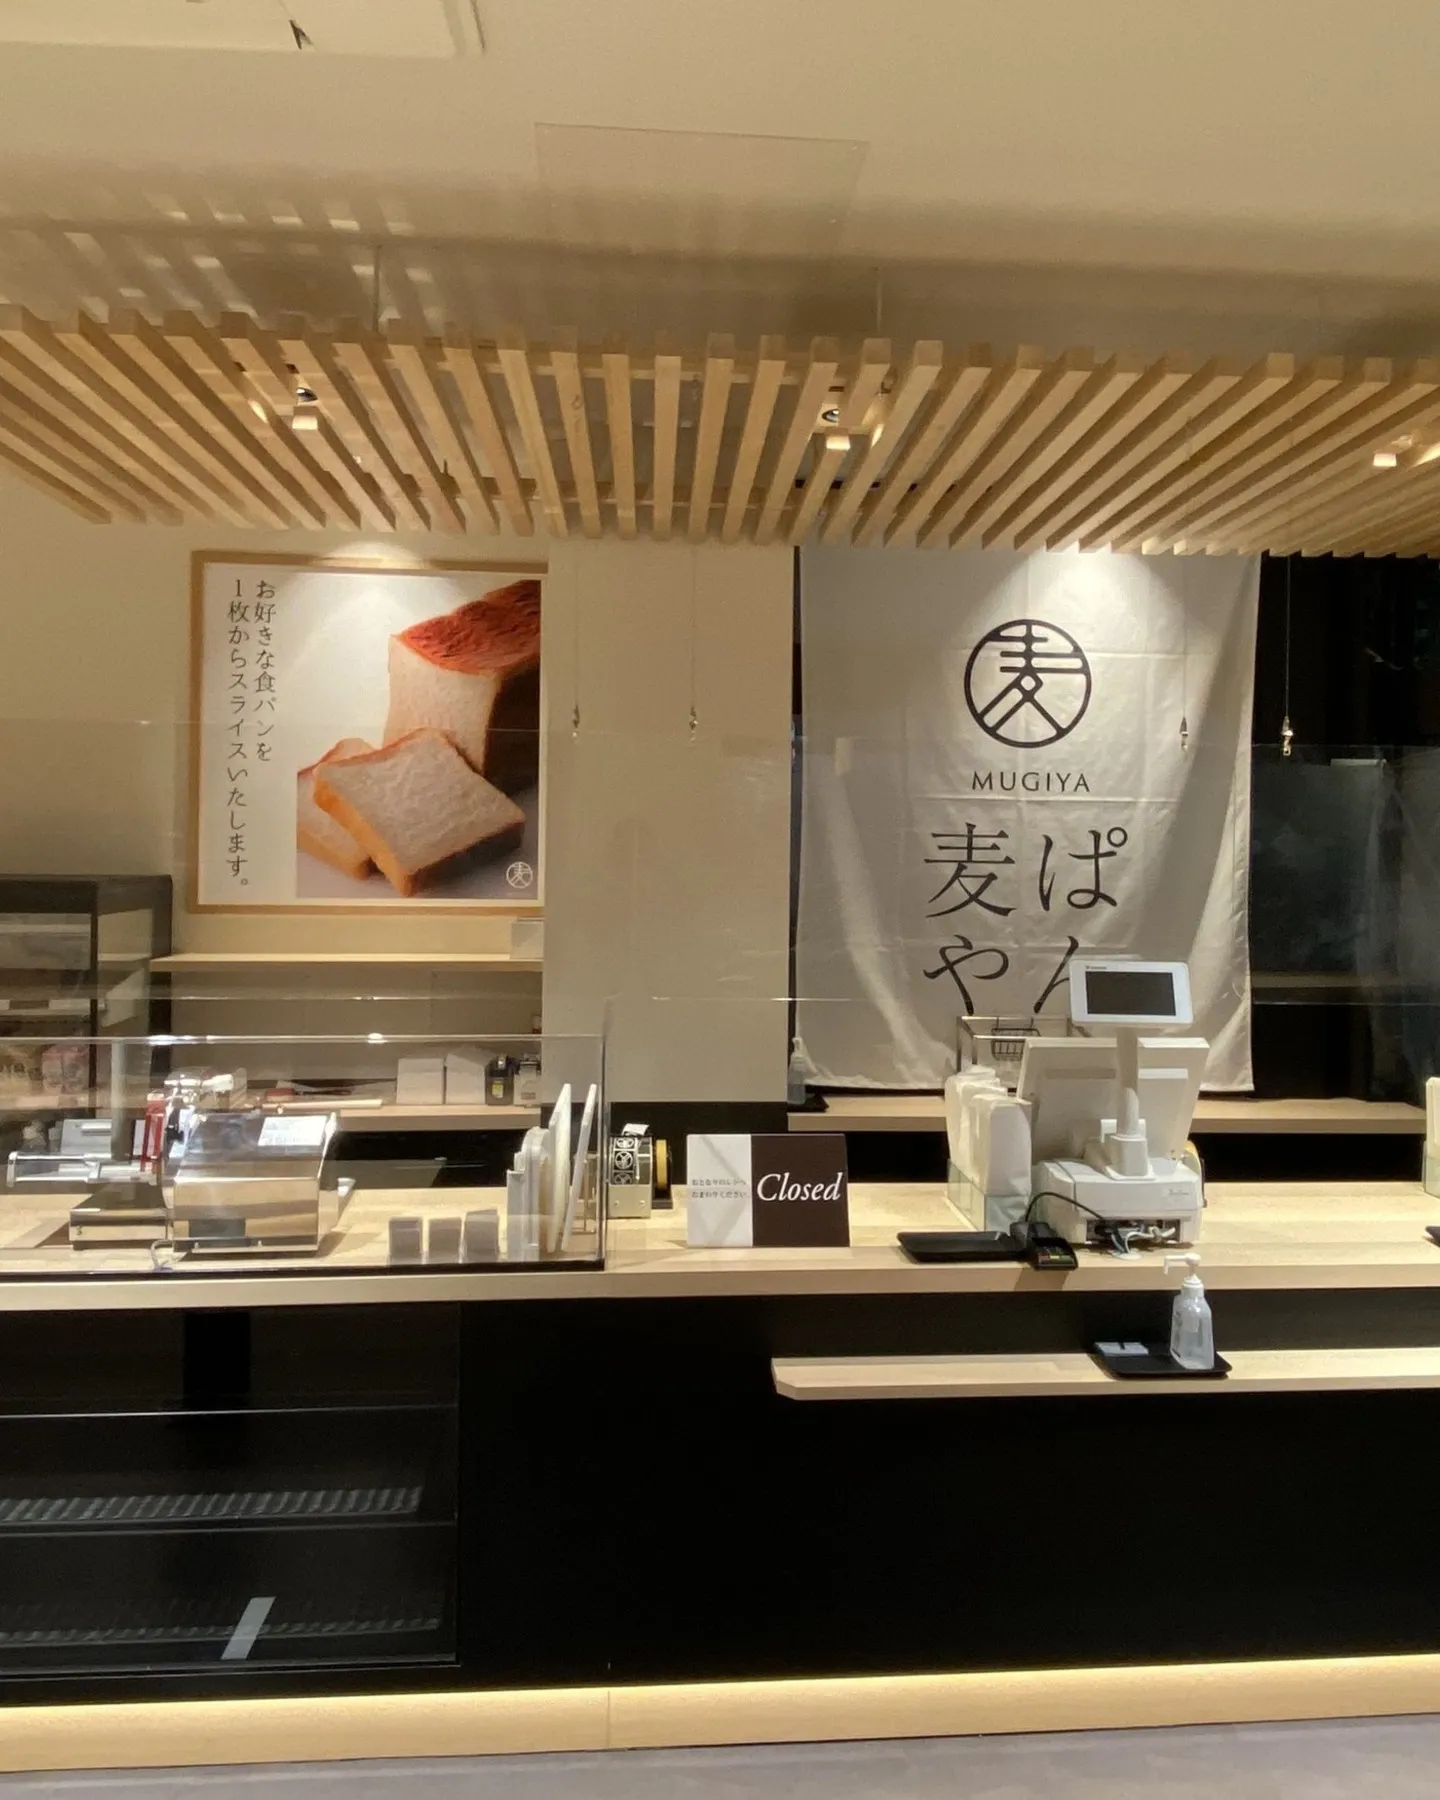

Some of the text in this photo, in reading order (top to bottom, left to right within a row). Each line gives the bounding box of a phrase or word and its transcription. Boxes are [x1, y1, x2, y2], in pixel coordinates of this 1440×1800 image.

[253, 579, 277, 762] お好きな食パンを
[226, 579, 251, 886] 1枚からスライスいたします。
[971, 770, 1090, 793] MUGIYA
[757, 1172, 843, 1201] Closed
